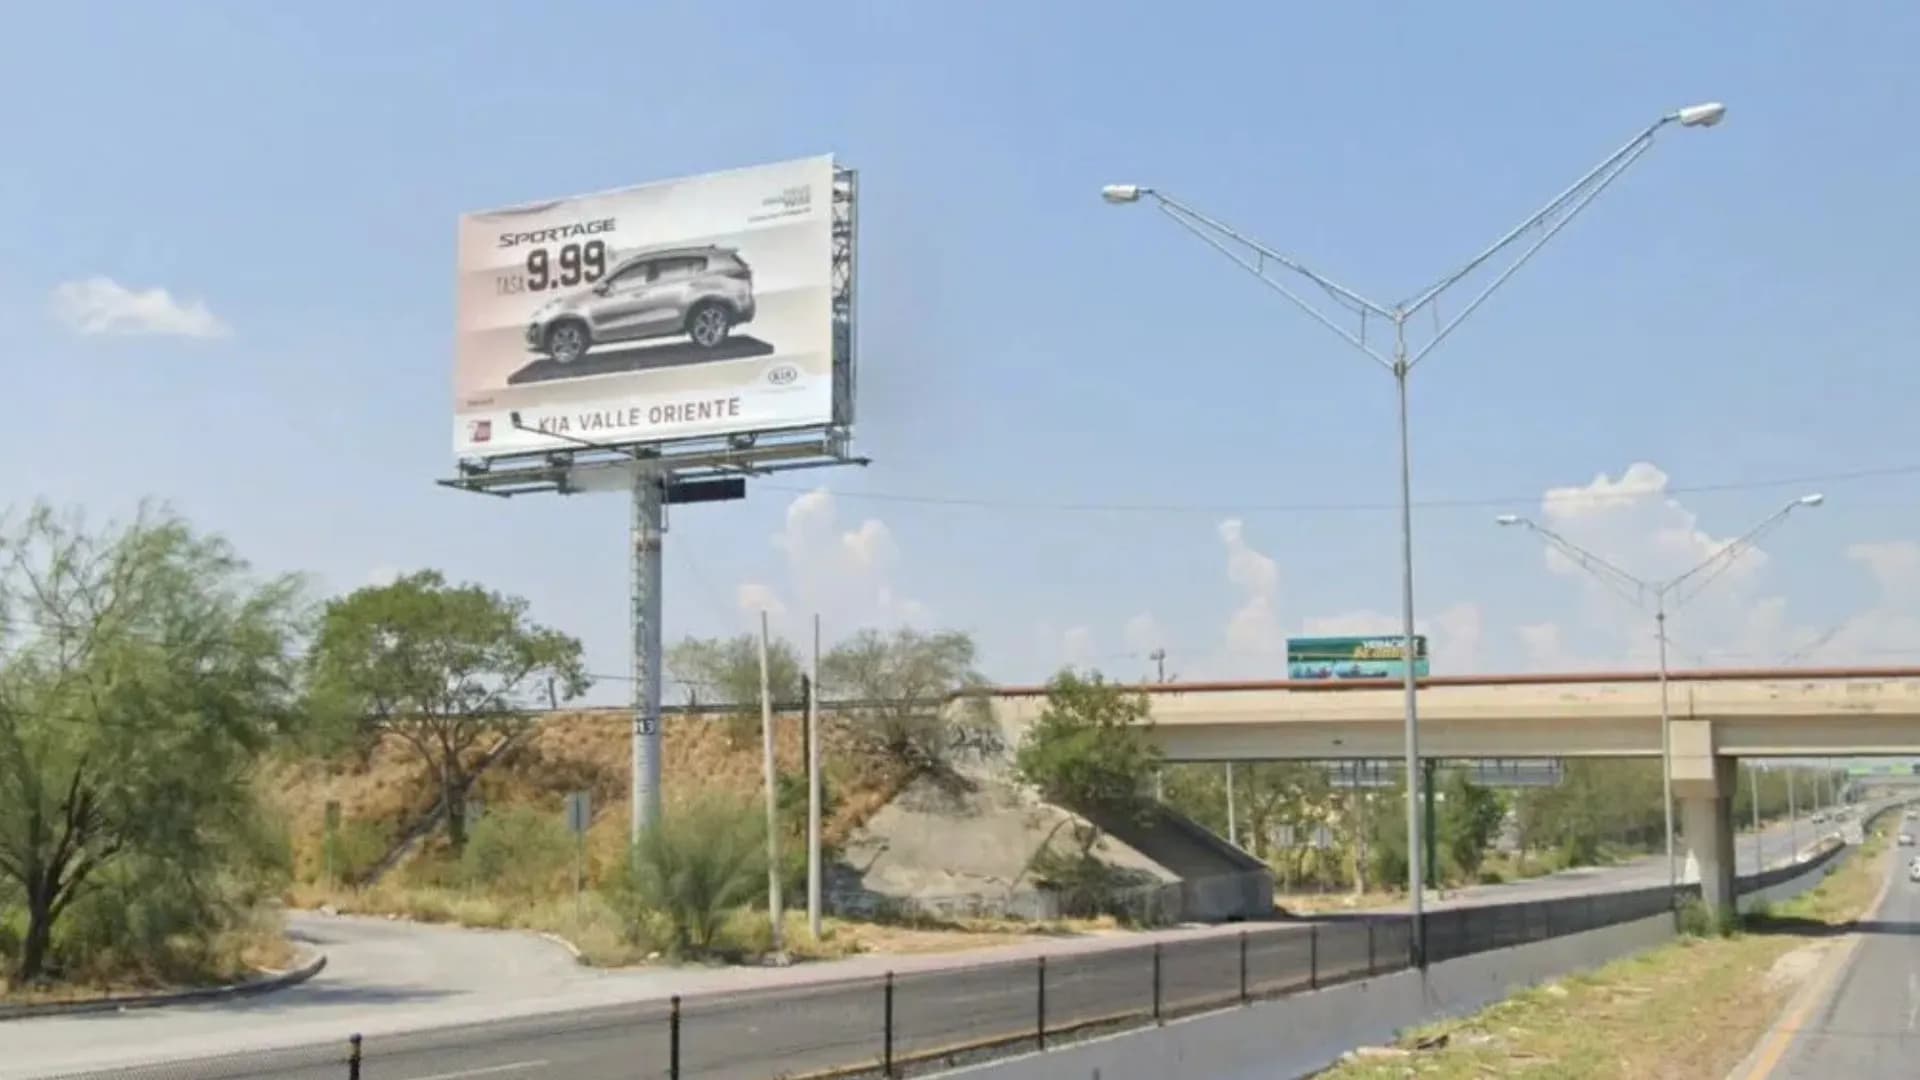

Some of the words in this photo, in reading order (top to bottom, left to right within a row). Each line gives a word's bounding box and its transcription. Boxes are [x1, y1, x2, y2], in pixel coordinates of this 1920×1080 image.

[498, 218, 616, 248] SPORTAGE
[539, 416, 570, 433] KIA
[579, 408, 641, 431] VALLE
[649, 397, 740, 425] ORIENTE
